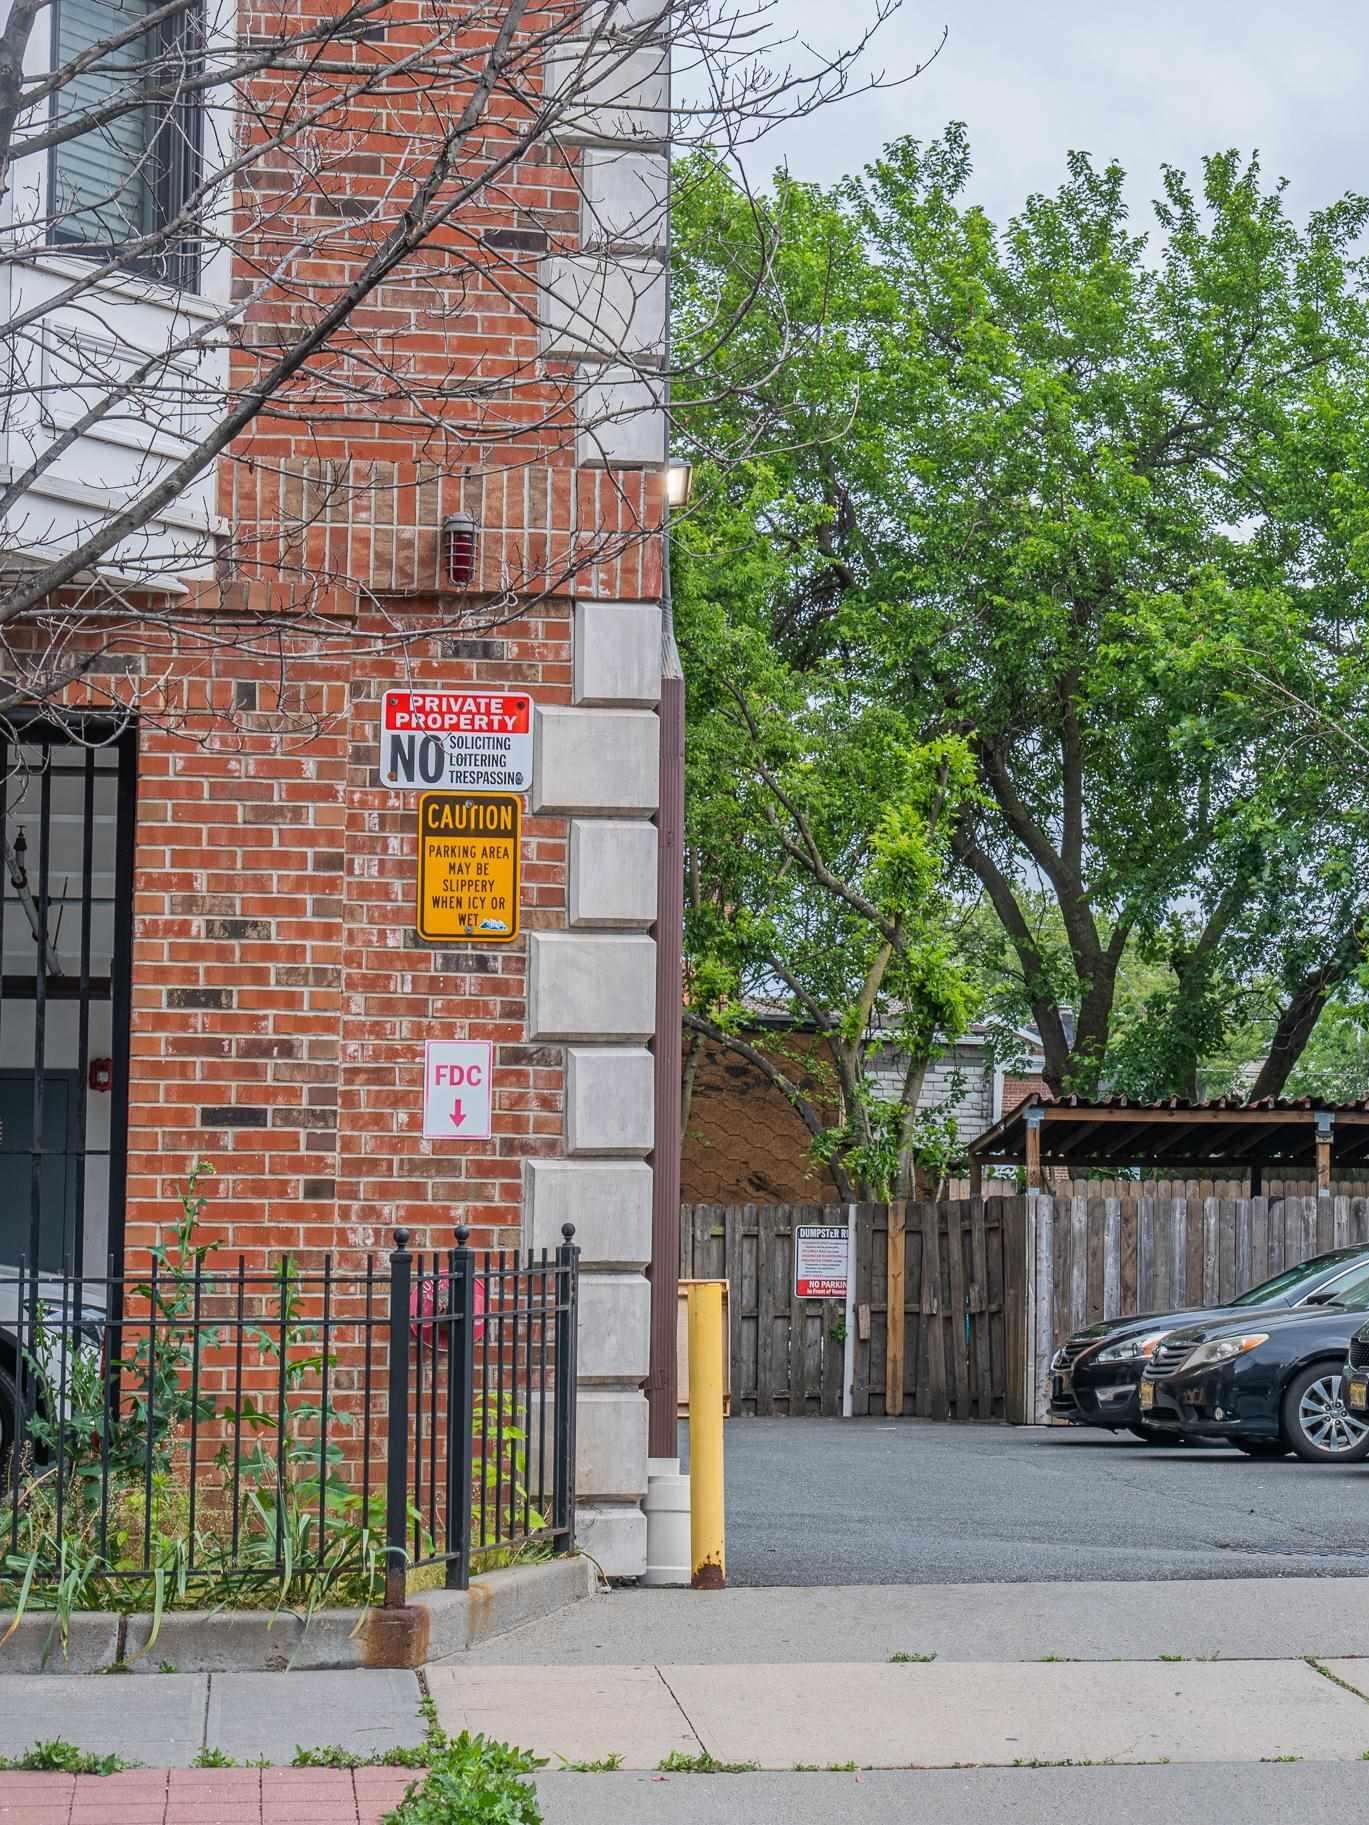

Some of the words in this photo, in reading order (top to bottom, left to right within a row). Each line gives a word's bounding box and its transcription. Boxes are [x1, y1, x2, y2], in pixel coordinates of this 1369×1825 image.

[409, 695, 504, 714] PRIVATE
[395, 712, 518, 731] PROPERTY
[449, 735, 511, 751] SOLICITING
[390, 734, 445, 784] NO
[450, 753, 507, 768] LOITERING
[449, 770, 524, 786] TRESPASSING
[428, 803, 513, 831] CAUTION
[429, 844, 477, 859] PARKING
[481, 847, 510, 859] AREA
[448, 863, 472, 875] MAY
[476, 863, 489, 876] BE
[442, 880, 495, 892] SLIPPERY
[432, 896, 462, 909] WHEN
[468, 896, 486, 910] ICY
[491, 897, 505, 910] OR
[458, 913, 479, 927] WET
[435, 1065, 482, 1087] FDC
[800, 1228, 839, 1238] DUMPSTER
[809, 1280, 820, 1289] NO
[821, 1280, 847, 1289] PARKIN
